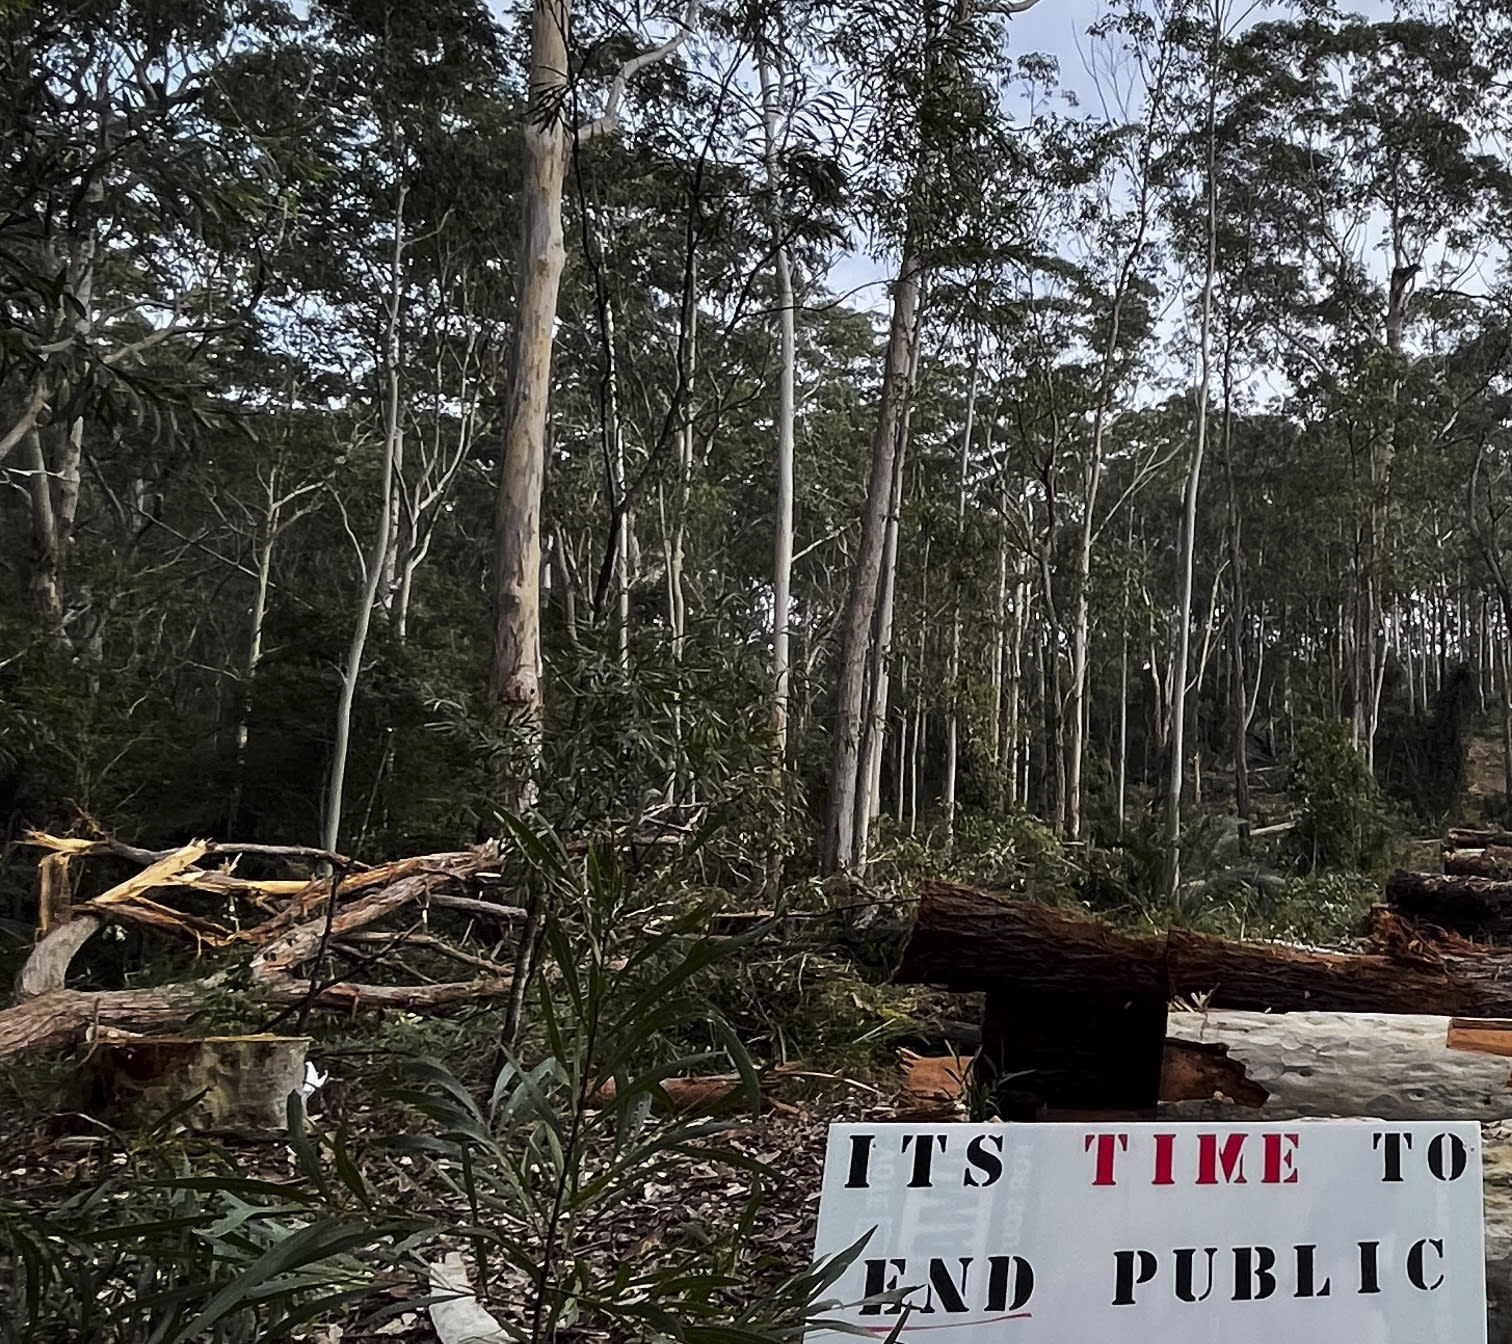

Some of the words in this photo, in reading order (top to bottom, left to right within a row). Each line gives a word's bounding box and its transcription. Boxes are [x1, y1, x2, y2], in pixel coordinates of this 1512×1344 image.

[843, 1133, 1004, 1189] ITS
[1084, 1133, 1299, 1186] TIME
[1372, 1131, 1468, 1183] TO
[857, 1254, 1036, 1316] END
[1110, 1237, 1446, 1306] PUBLIC
